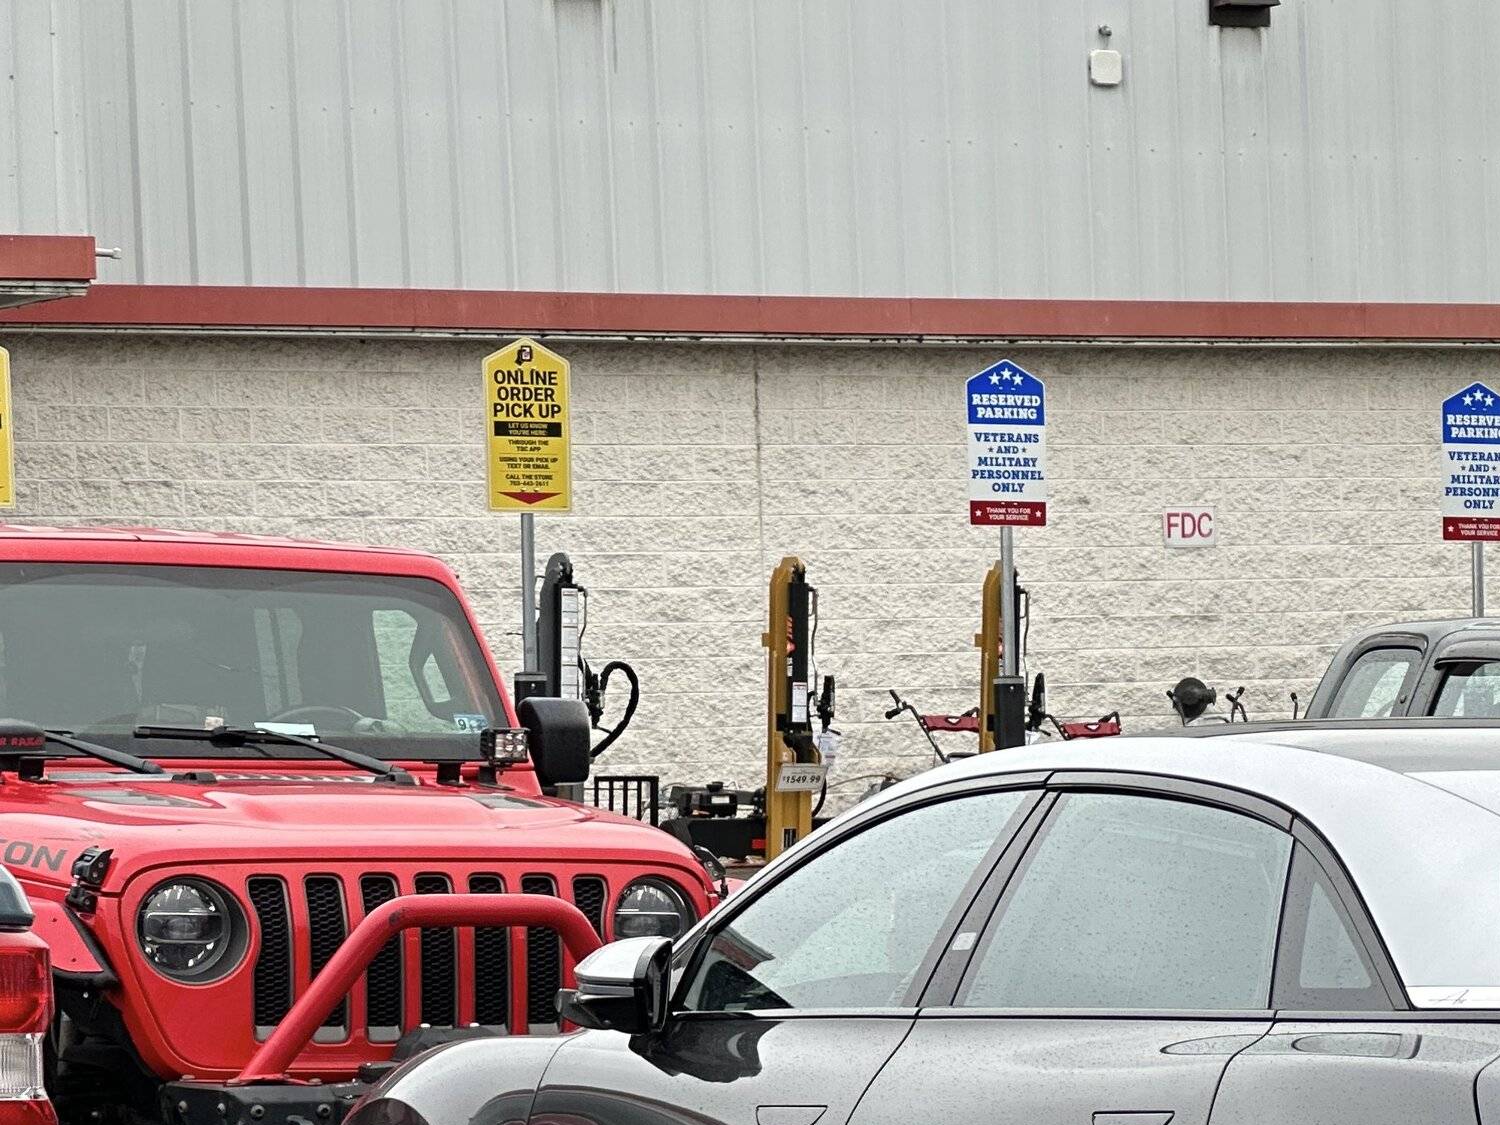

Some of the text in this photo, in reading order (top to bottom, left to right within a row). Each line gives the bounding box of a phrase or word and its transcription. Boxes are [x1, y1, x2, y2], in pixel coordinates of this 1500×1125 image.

[494, 370, 558, 386] ONLINE
[497, 386, 555, 402] ORDER
[972, 394, 1041, 407] RESERVED
[494, 403, 562, 419] PICK UP
[976, 407, 1037, 420] PARKING
[974, 432, 1039, 443] VETERANS
[996, 445, 1019, 454] AND
[978, 457, 1038, 467] MILITARY
[1468, 464, 1490, 473] AND
[971, 470, 1044, 480] PERSONNEL
[992, 483, 1025, 493] ONLY
[1464, 499, 1495, 509] ONLY
[1167, 512, 1213, 538] FDC
